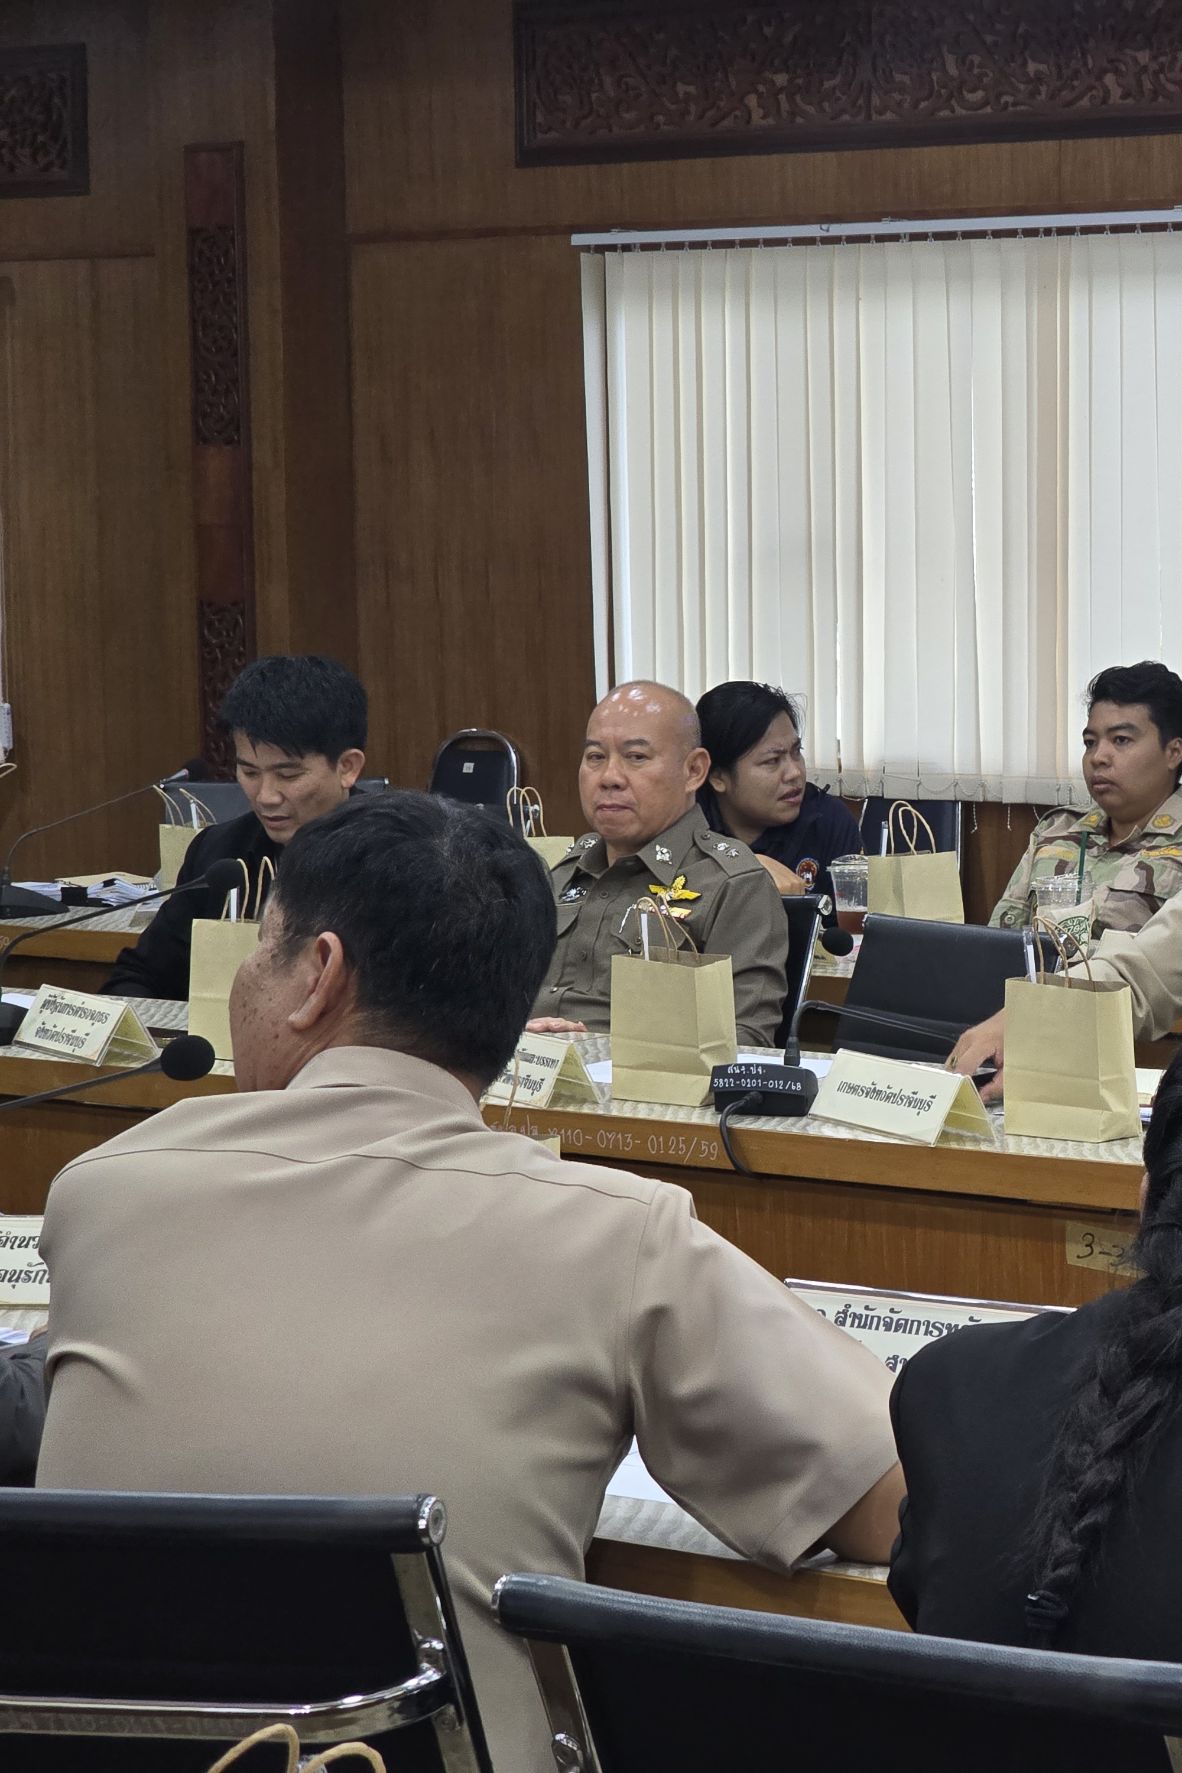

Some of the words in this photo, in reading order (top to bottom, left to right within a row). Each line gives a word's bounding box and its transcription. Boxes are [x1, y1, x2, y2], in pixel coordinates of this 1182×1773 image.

[713, 1078, 802, 1091] 5822-0201-012/68
[836, 1080, 936, 1116] เกษตรจังหวัดปราจีนบุรี
